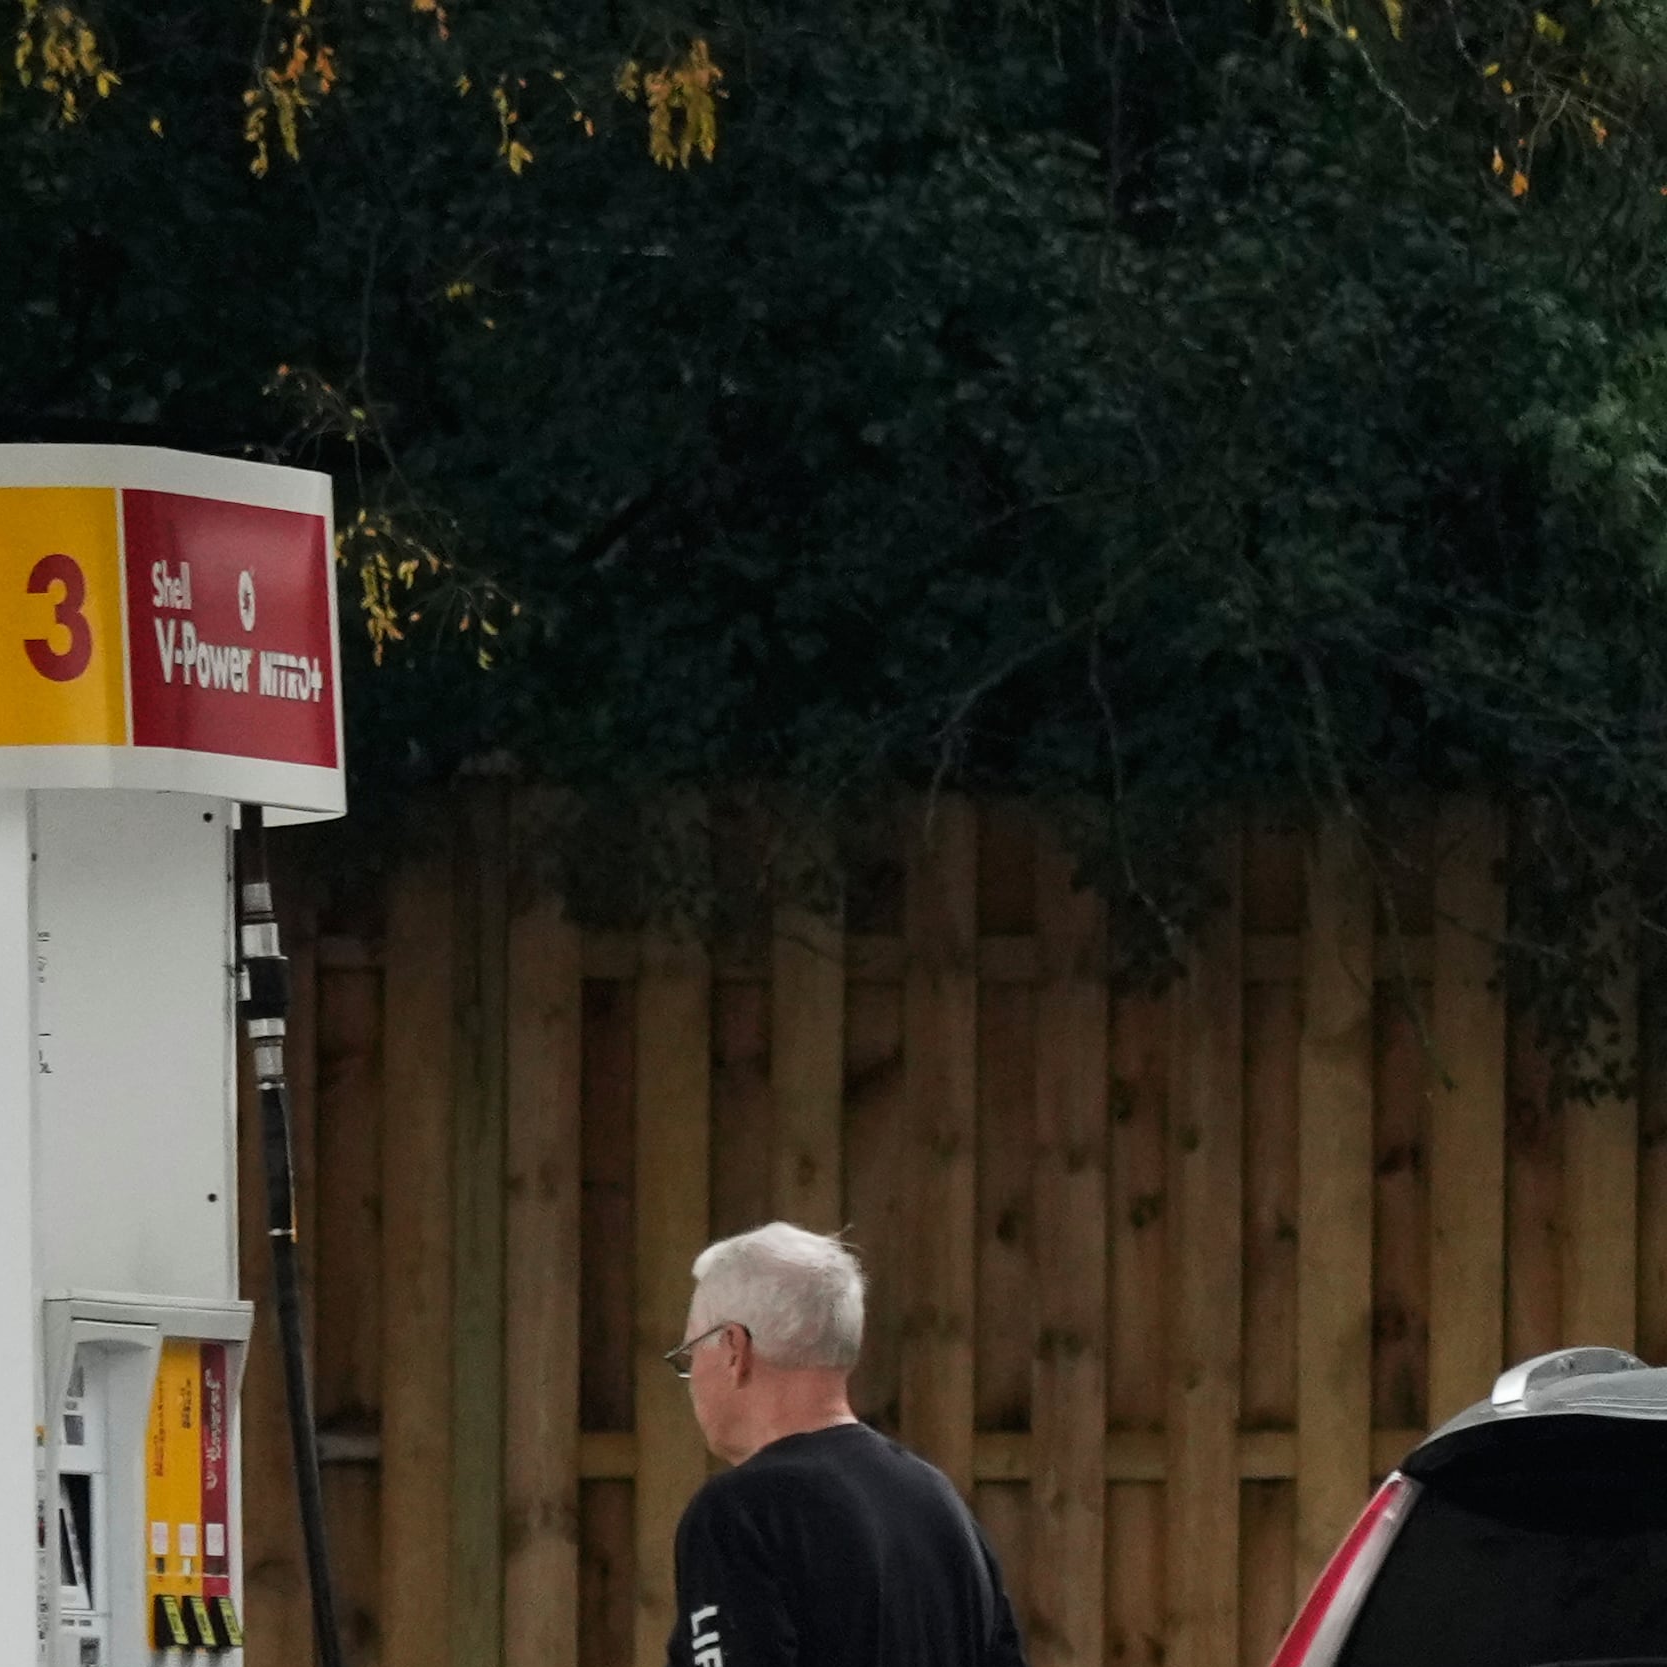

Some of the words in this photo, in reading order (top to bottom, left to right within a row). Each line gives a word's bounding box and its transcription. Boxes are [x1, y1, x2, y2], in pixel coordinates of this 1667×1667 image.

[24, 554, 92, 682] 3
[152, 560, 192, 610] Shell
[154, 616, 253, 693] V-Power
[259, 650, 323, 702] NITRO+
